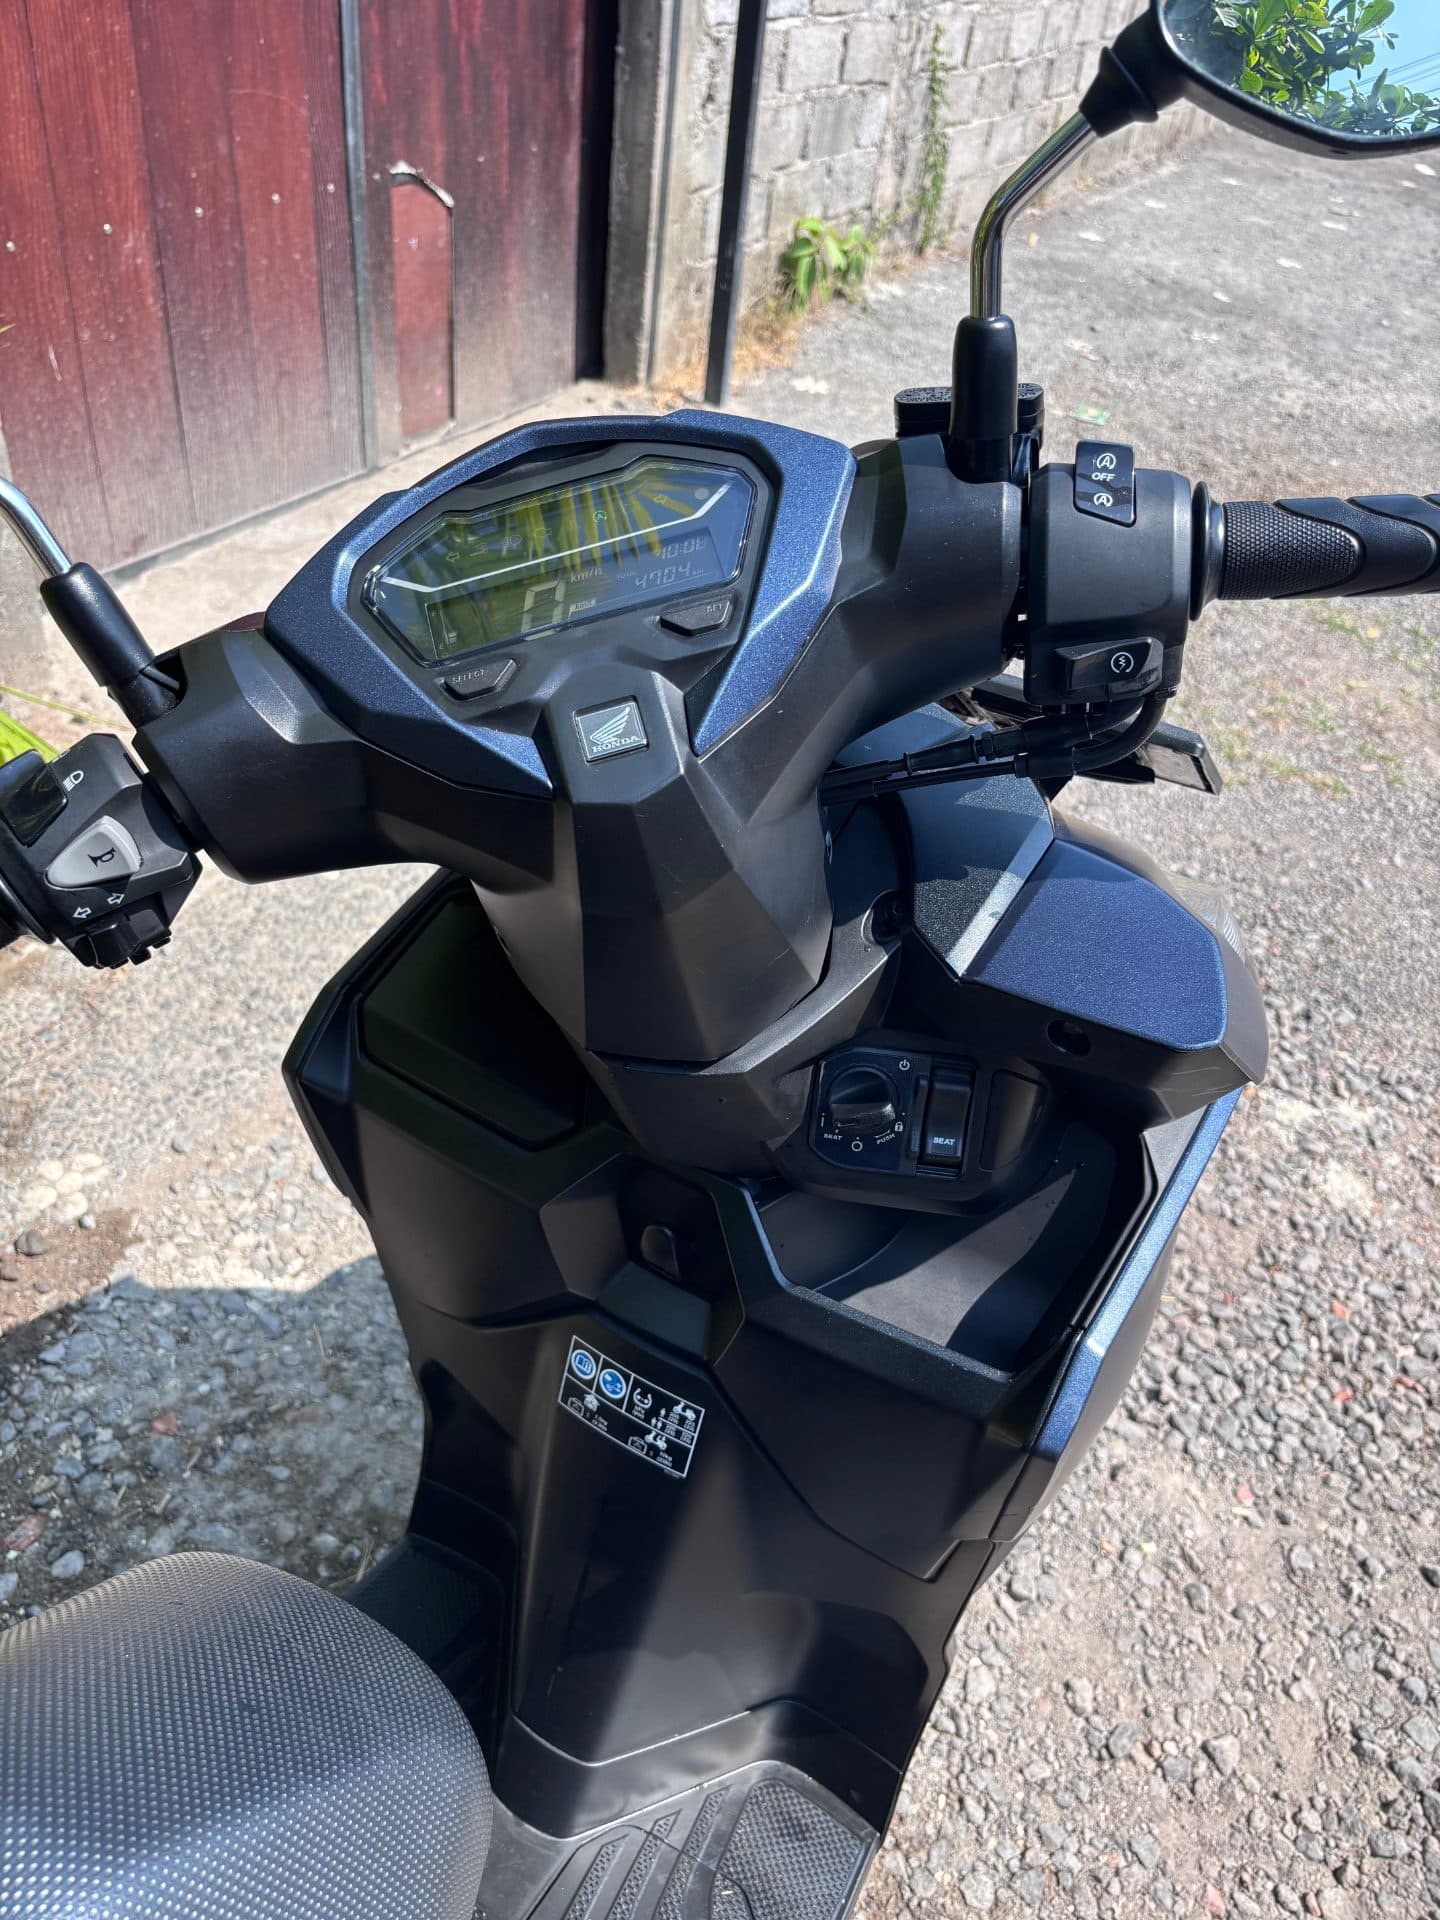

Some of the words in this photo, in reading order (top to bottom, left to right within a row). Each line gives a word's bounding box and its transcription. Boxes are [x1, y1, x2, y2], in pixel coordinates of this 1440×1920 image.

[1091, 472, 1115, 482] OFF
[635, 560, 691, 589] 4704
[452, 669, 485, 684] SELECT
[591, 735, 639, 753] HONDA
[823, 1132, 843, 1141] SEAT
[876, 1132, 896, 1145] PUSH
[932, 1136, 956, 1147] SEAT
